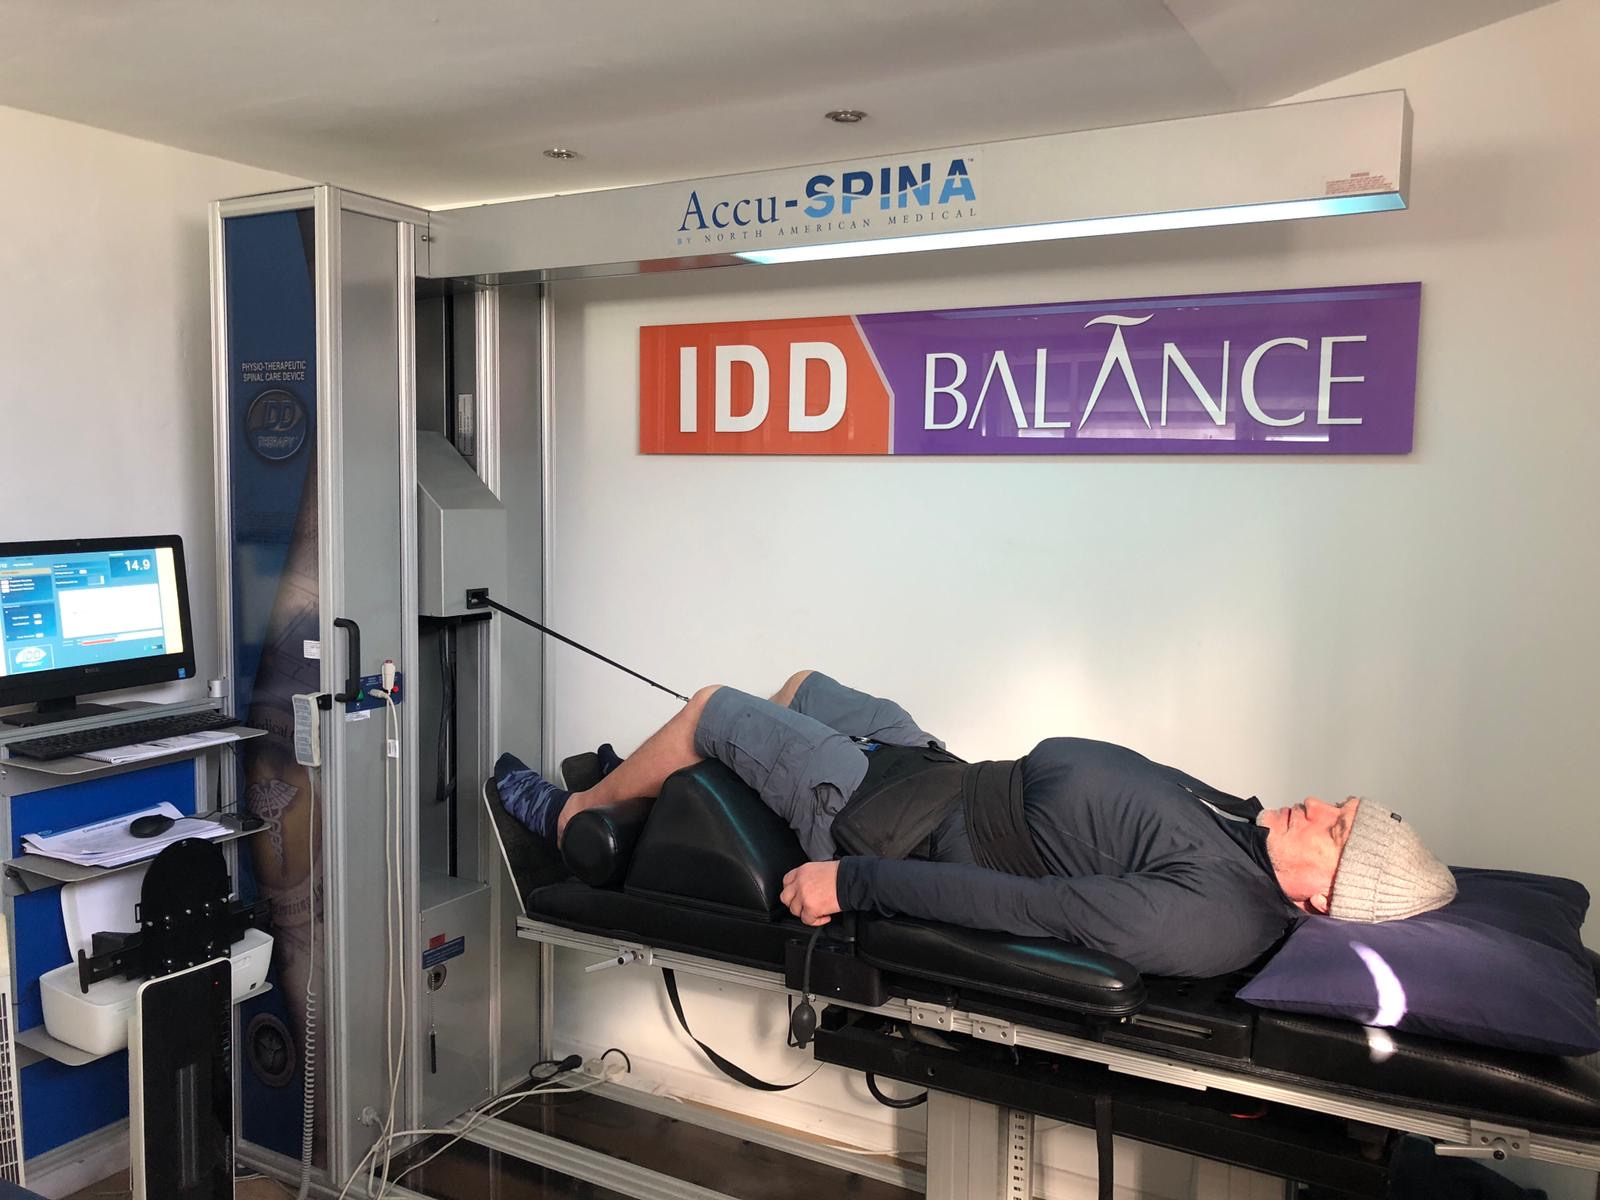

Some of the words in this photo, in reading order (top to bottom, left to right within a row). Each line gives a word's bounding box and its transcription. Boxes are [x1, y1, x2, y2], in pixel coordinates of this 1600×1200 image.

[677, 238, 692, 246] BY
[704, 229, 762, 243] NORTH
[778, 219, 871, 236] AMERICAN
[888, 207, 977, 225] MEDICAL
[241, 360, 307, 372] PHYSIO-THERAPEUTIC
[243, 373, 265, 382] SPINAL
[265, 373, 282, 382] CARE
[283, 371, 305, 381] DEVICE
[680, 341, 848, 433] IDD
[924, 314, 1367, 431] BALANCE
[125, 558, 151, 572] 14.9
